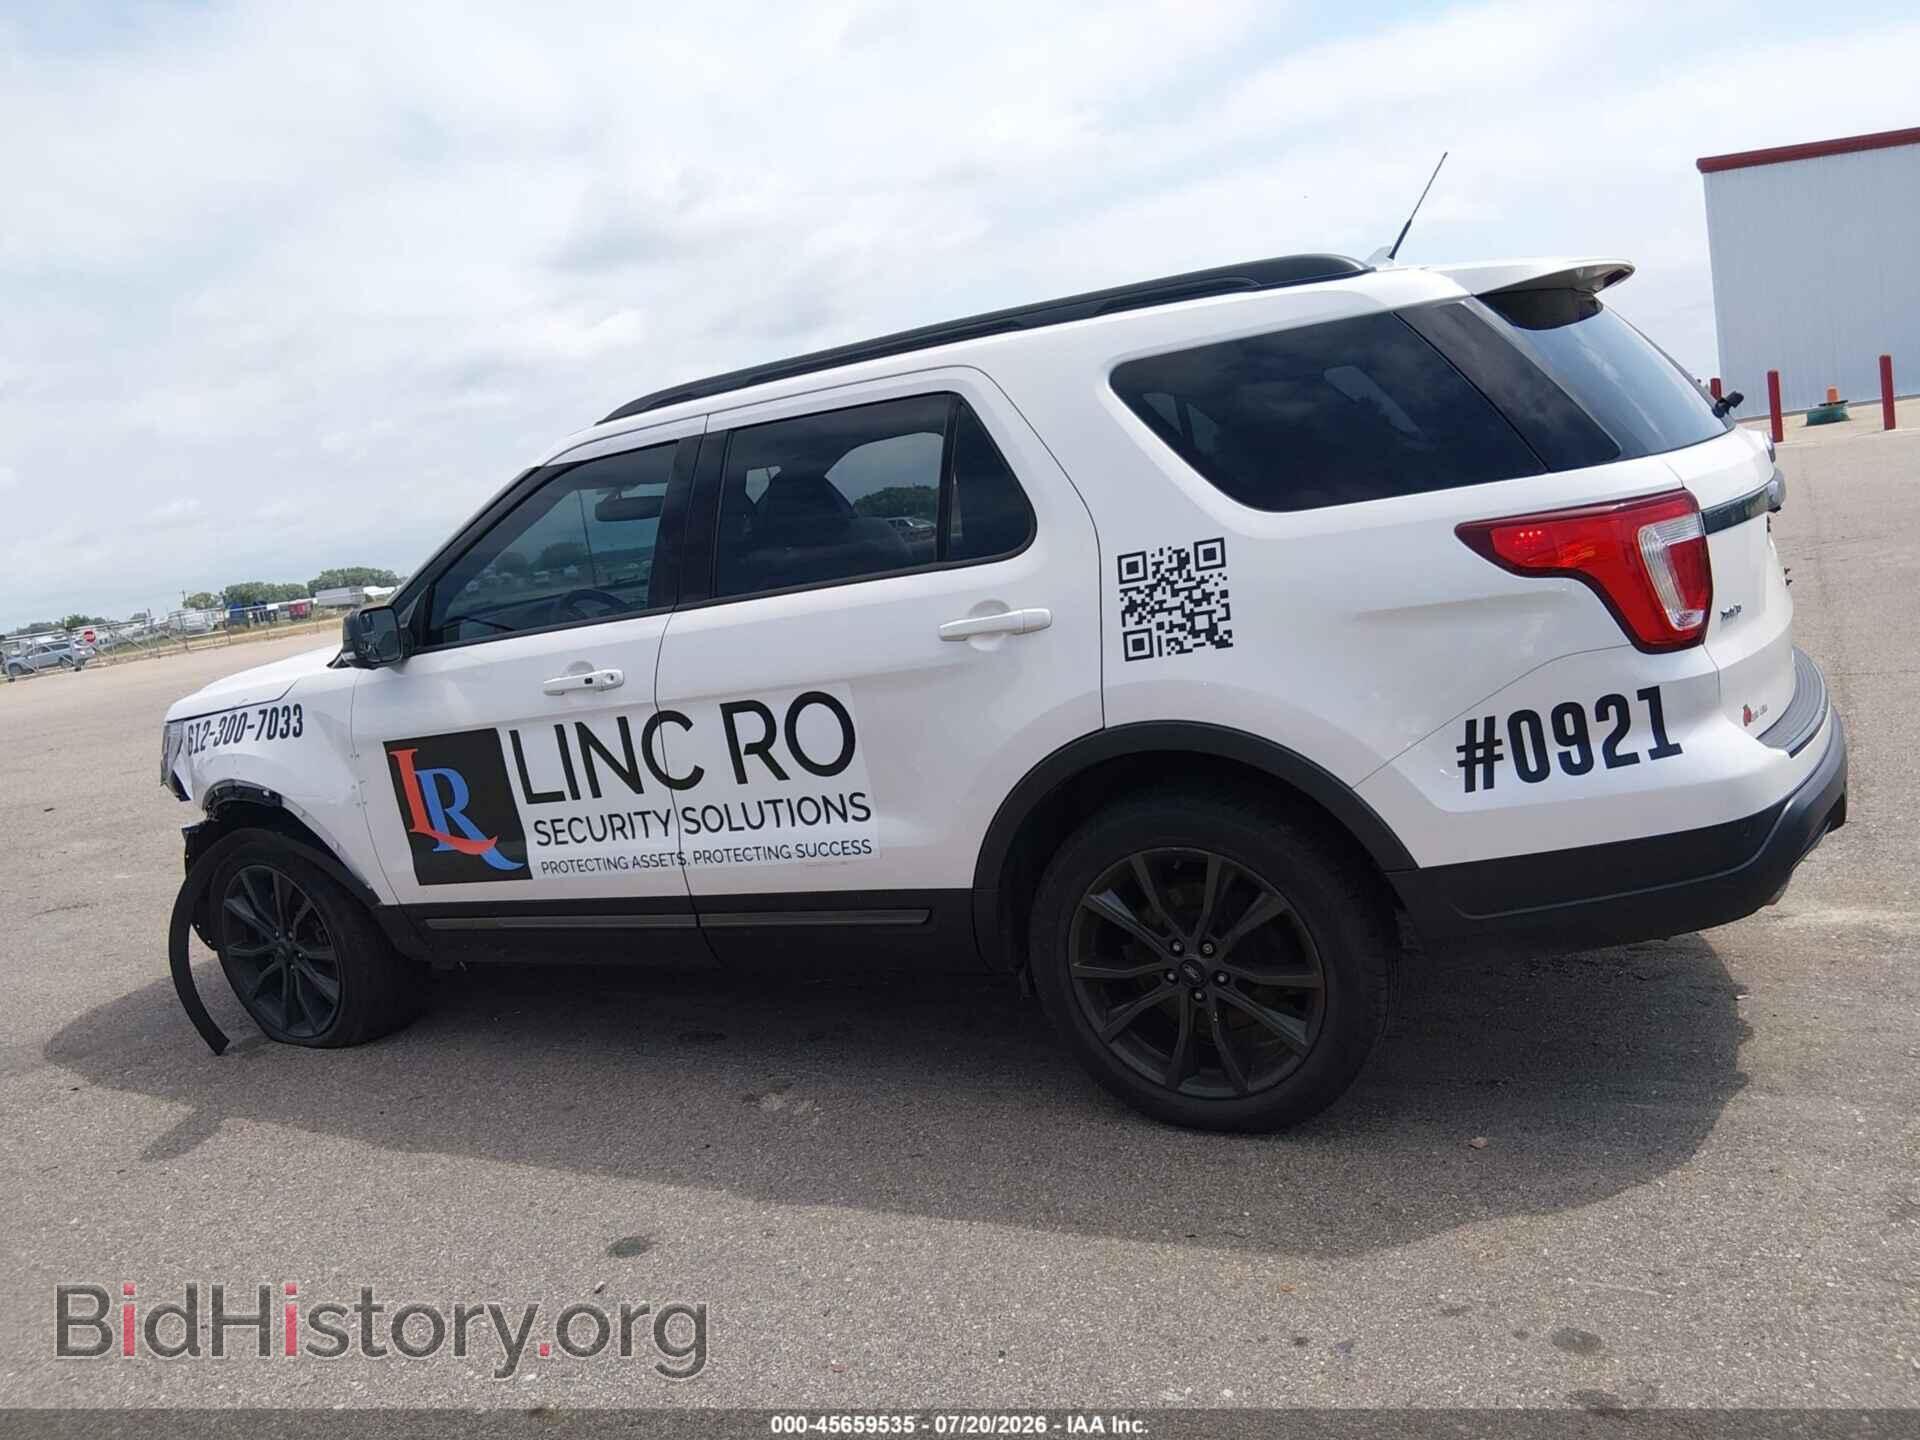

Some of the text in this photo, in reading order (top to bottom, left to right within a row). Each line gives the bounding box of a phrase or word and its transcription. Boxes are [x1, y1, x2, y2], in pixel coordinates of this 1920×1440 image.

[187, 703, 304, 757] 612-300-7033
[508, 691, 856, 805] LINC RO
[1455, 685, 1684, 793] #0921
[533, 792, 872, 847] SECURITY SOLUTIONS
[541, 855, 629, 875] PROTECTING
[693, 844, 796, 866] PROTECTING
[794, 838, 873, 859] SUCCESS
